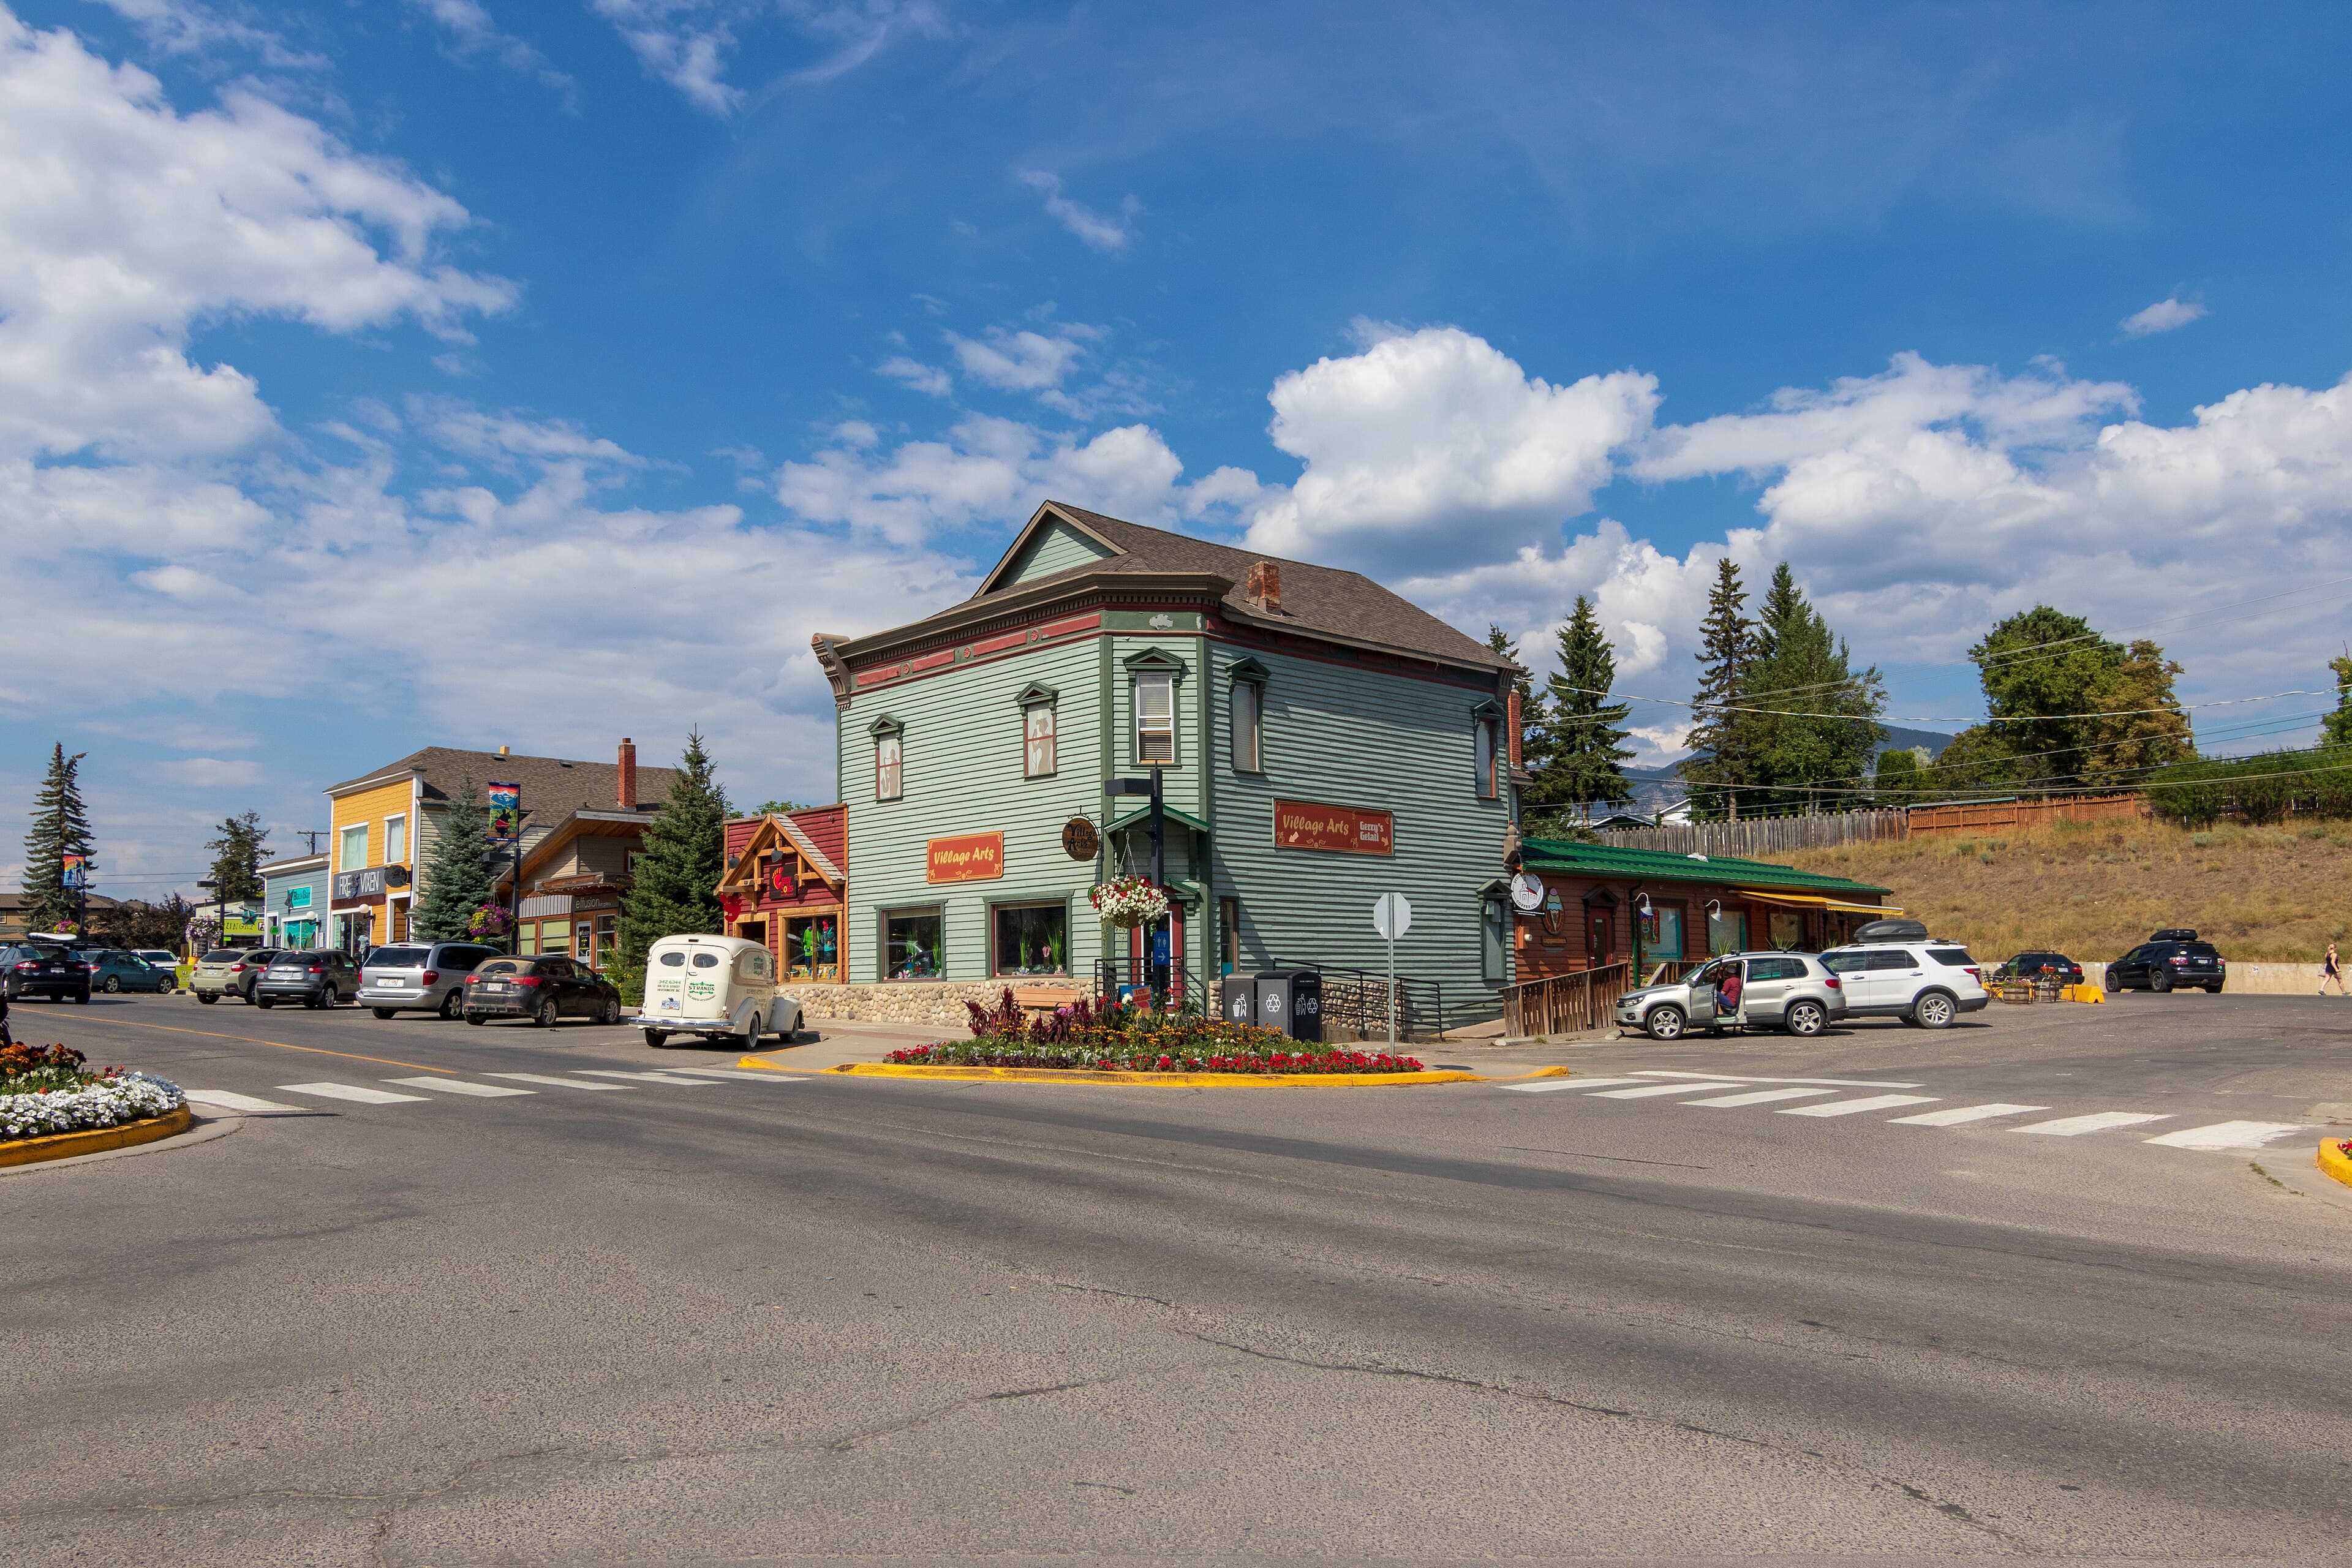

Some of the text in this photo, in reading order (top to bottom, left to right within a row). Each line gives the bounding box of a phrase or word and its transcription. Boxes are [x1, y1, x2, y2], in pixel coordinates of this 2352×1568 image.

[1066, 823, 1096, 841] Village
[1283, 815, 1349, 835] Village Arts
[1359, 821, 1384, 832] Gerry's
[1068, 837, 1088, 851] Arts
[934, 846, 994, 865] Village Arts
[360, 871, 380, 892] VIXEN
[576, 897, 600, 909] effusion
